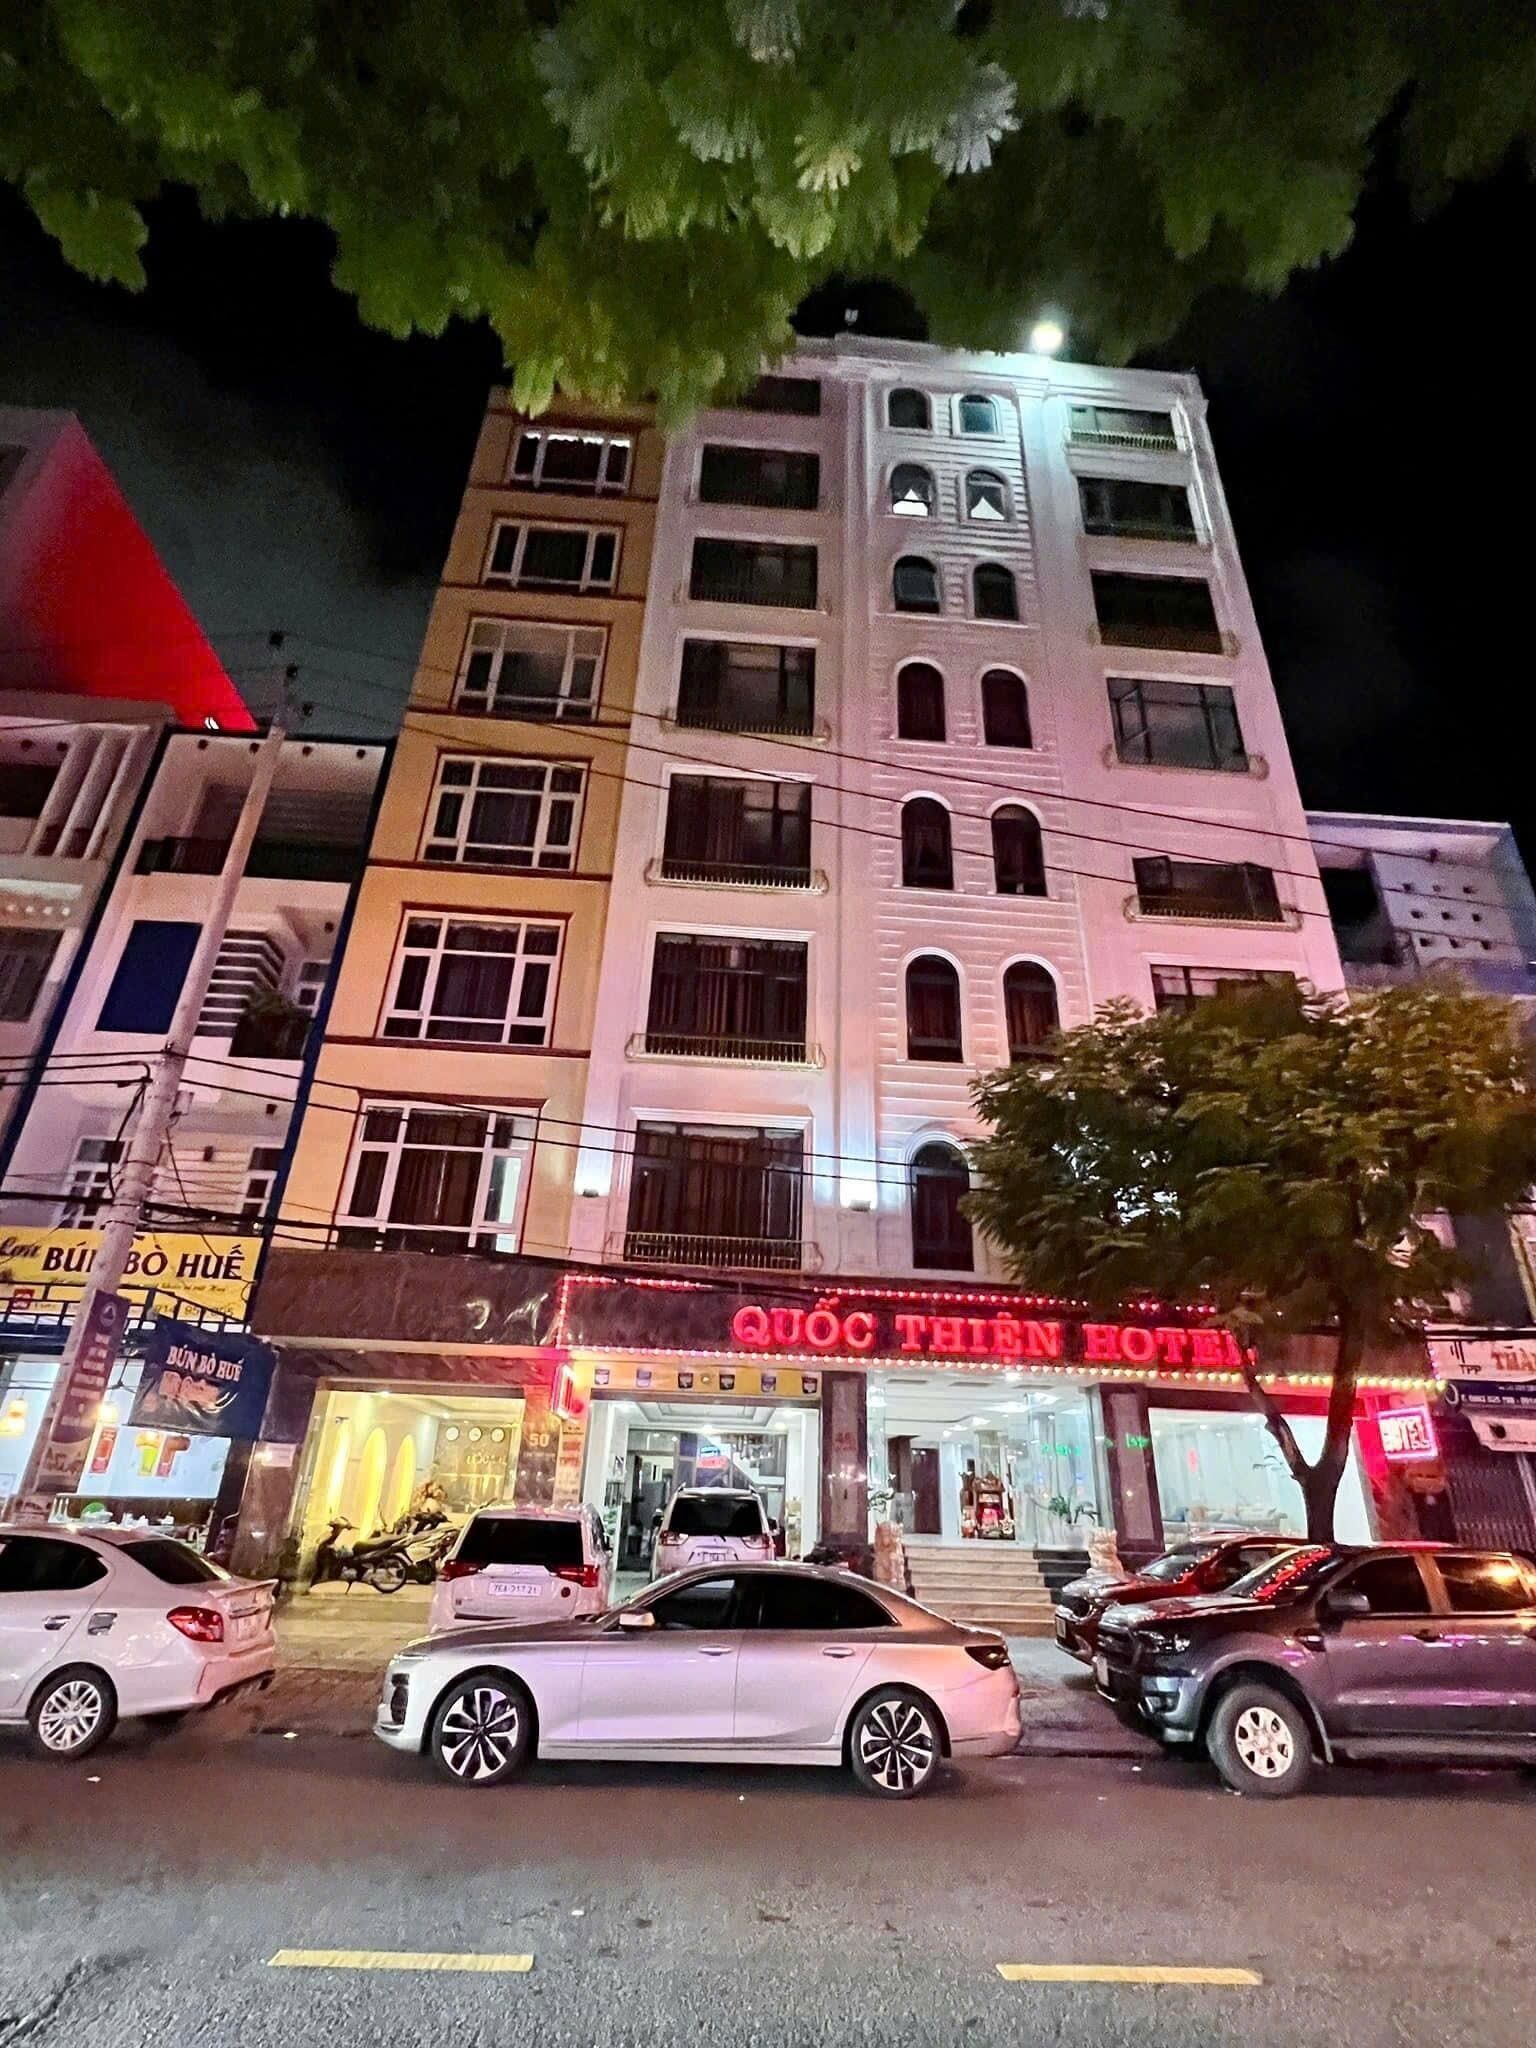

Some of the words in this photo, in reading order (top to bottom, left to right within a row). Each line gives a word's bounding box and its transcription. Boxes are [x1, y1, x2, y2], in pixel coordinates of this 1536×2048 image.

[123, 1244, 168, 1276] BÒ
[176, 1244, 245, 1279] HUẾ
[733, 1297, 874, 1349] QUỐC
[166, 1344, 198, 1370] BÚN
[197, 1352, 217, 1375] BÒ
